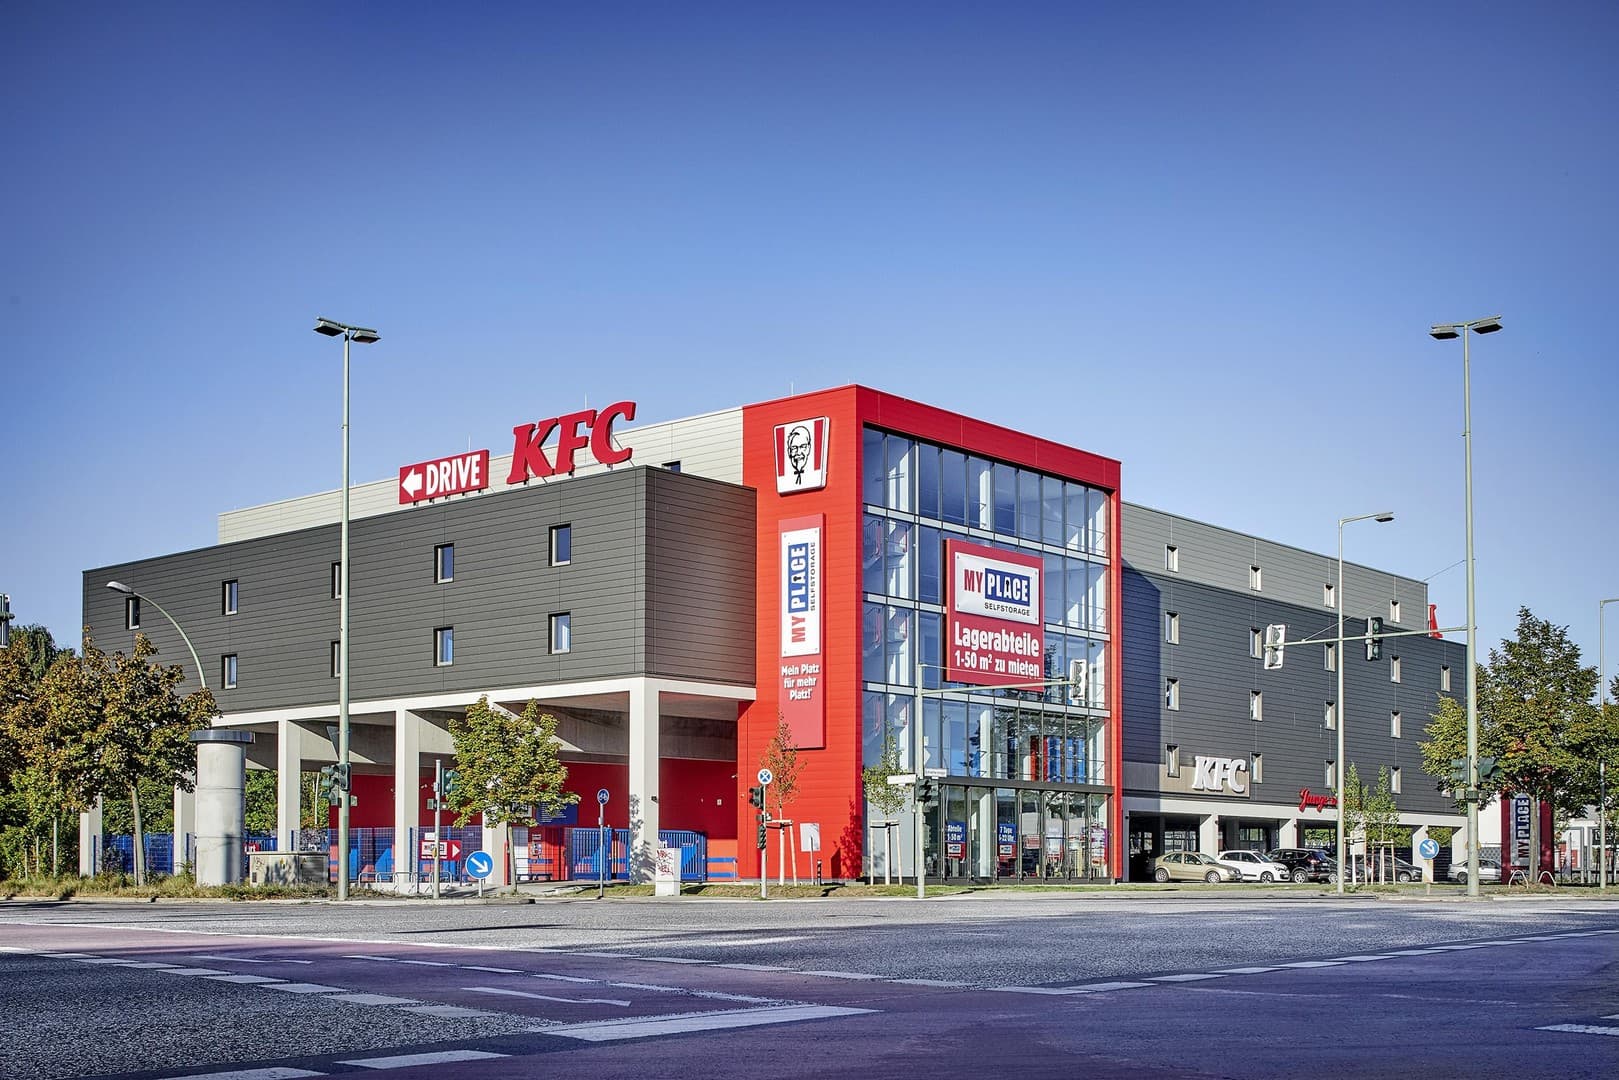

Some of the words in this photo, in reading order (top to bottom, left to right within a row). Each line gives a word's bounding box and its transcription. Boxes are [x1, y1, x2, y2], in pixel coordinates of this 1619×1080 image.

[506, 400, 637, 485] KFC
[426, 454, 481, 496] DRIVE
[790, 543, 806, 610] PLACE
[964, 569, 983, 593] MY
[987, 573, 1029, 602] PLACE
[984, 602, 1031, 616] SELFSTORAGE
[791, 616, 806, 643] MY
[954, 621, 1040, 658] Lagerabteile
[781, 665, 800, 676] Mein
[801, 663, 820, 674] Platz
[954, 650, 977, 669] 1-50
[995, 658, 1005, 673] zu
[1008, 659, 1040, 678] mieten
[784, 677, 795, 689] für
[797, 676, 817, 688] mehr
[1191, 755, 1246, 793] KFC
[1517, 799, 1530, 838] PLACE
